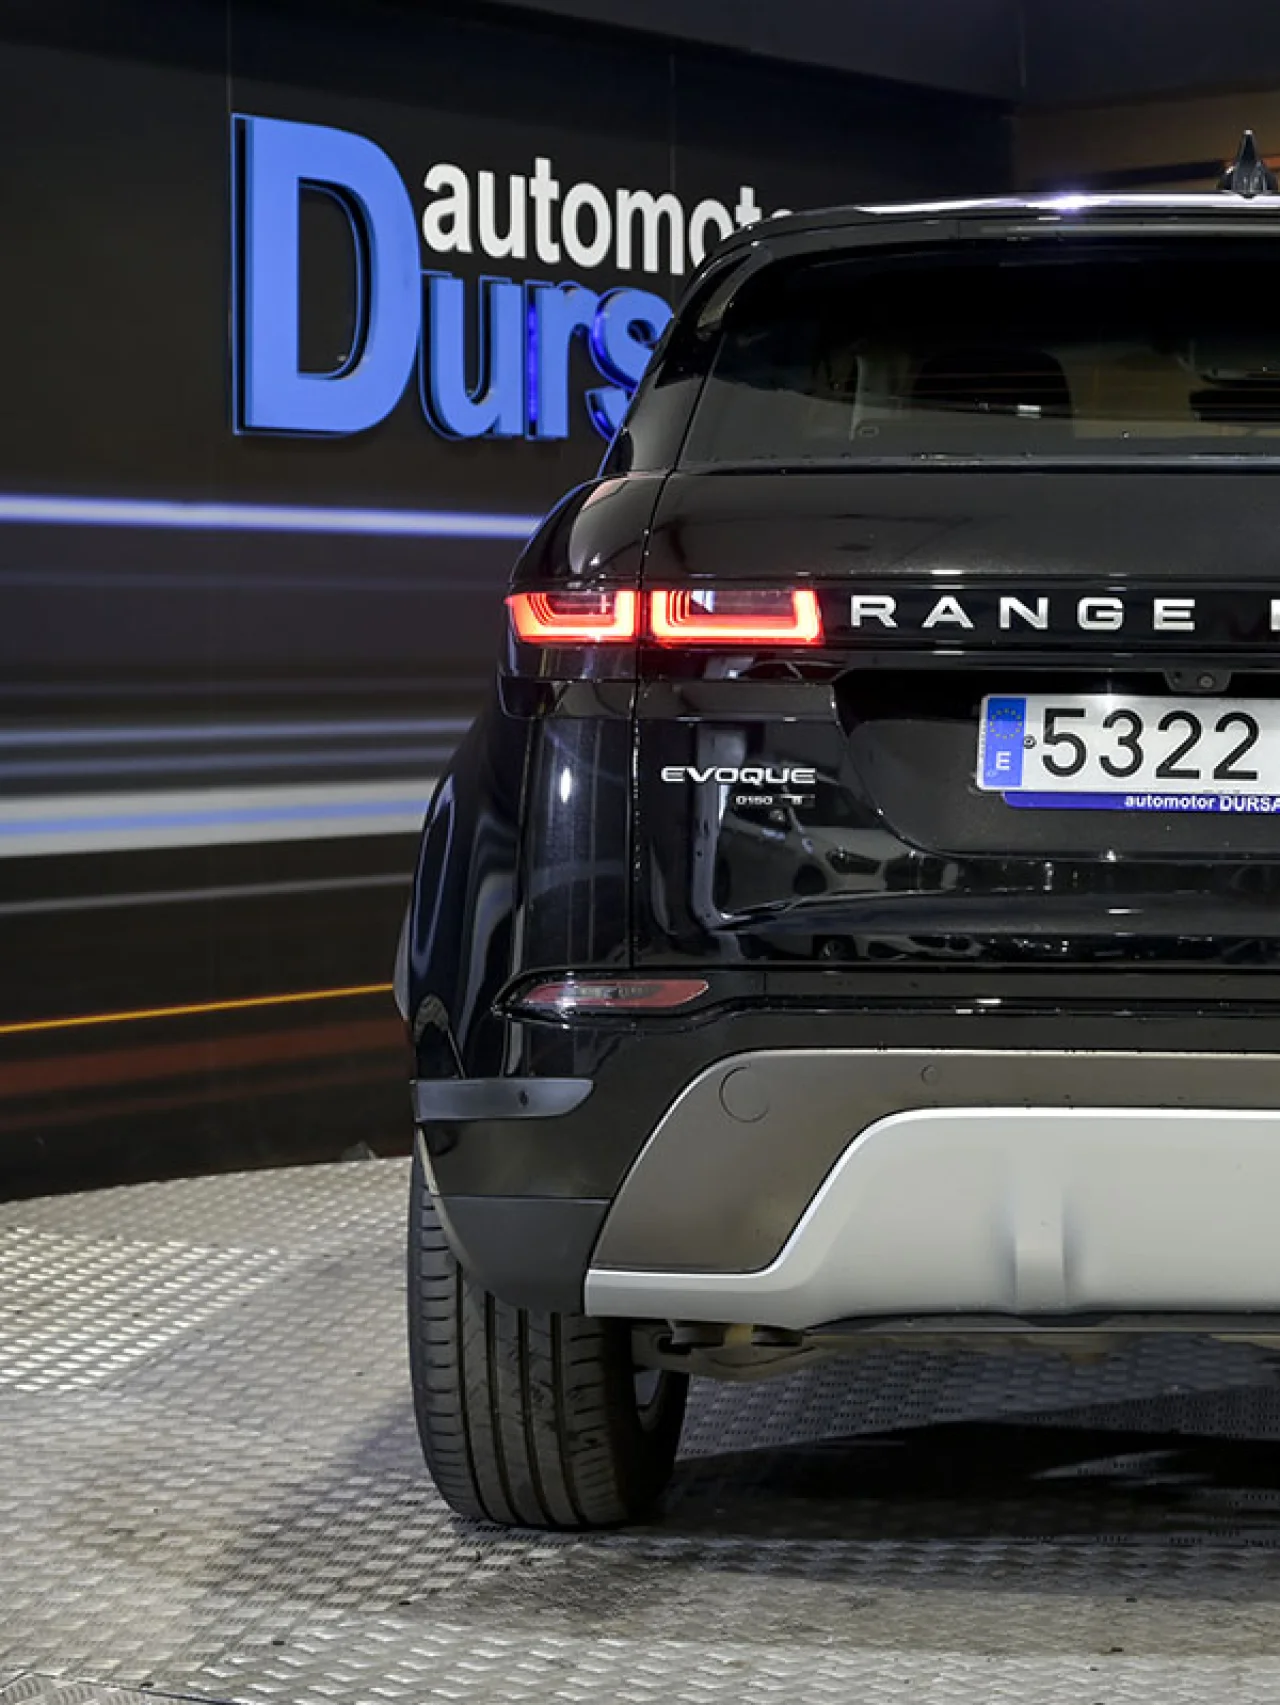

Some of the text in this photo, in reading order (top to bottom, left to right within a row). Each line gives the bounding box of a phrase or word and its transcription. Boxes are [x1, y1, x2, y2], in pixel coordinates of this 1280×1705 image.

[850, 594, 1195, 631] RANGE
[1042, 708, 1259, 779] 5322
[996, 750, 1011, 771] E
[661, 766, 816, 786] EVOQUE
[1125, 793, 1215, 808] automotor
